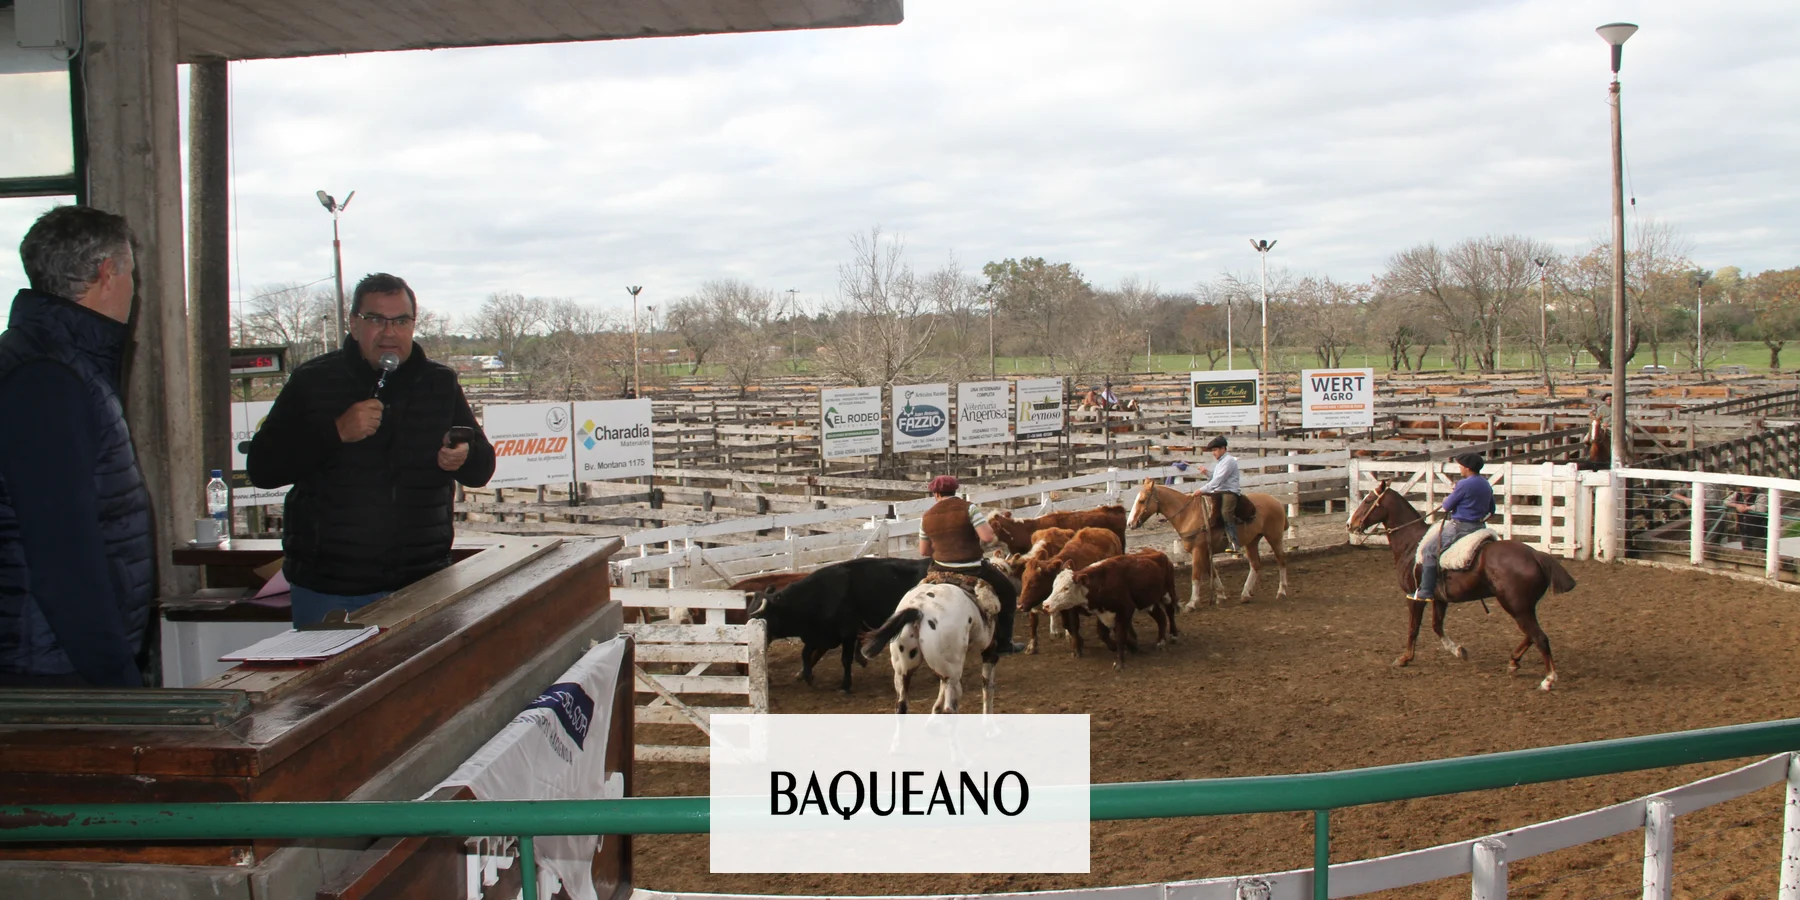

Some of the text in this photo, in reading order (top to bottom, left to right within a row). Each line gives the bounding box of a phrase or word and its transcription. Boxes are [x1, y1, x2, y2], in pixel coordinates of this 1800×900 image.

[1311, 377, 1365, 392] WERT
[1323, 392, 1353, 401] AGRO
[965, 401, 997, 411] Veterinaria
[1019, 401, 1060, 424] Reynoso
[834, 412, 880, 424] EL RODEO
[960, 407, 1007, 424] Angerosa
[595, 423, 649, 441] Charadía
[494, 437, 568, 457] GRANAZO
[584, 458, 646, 471] Bv. Montana 1175
